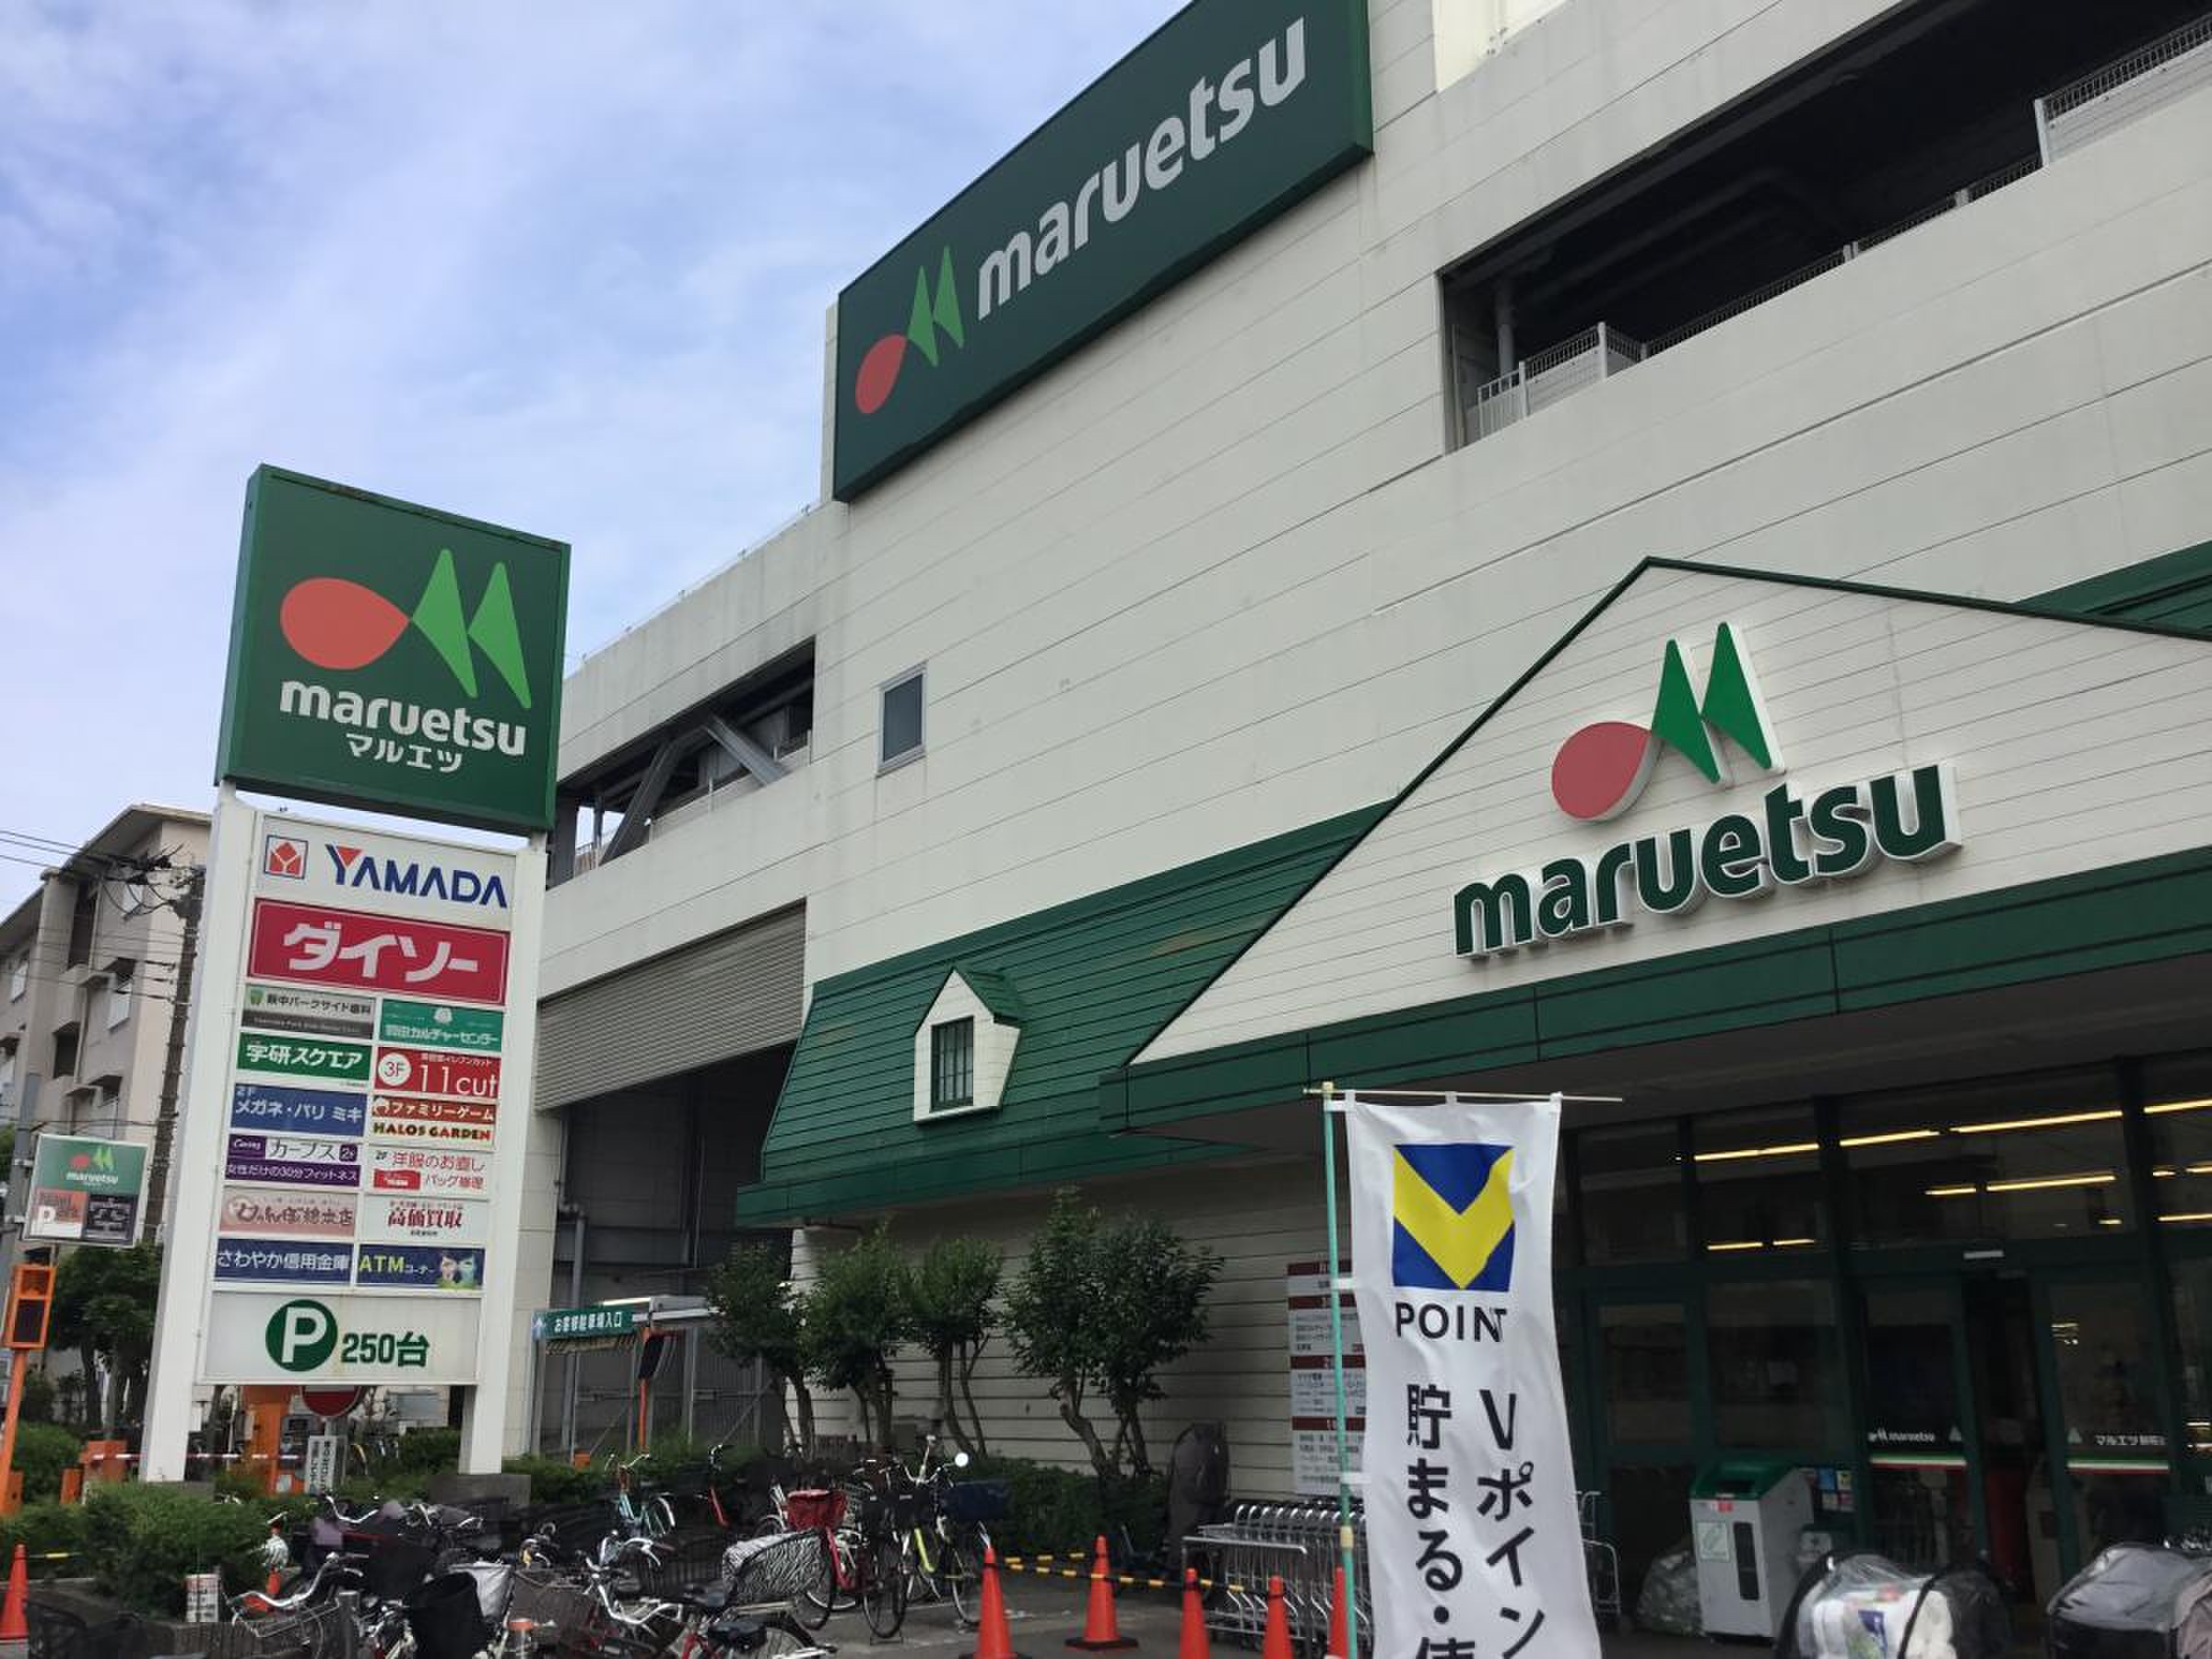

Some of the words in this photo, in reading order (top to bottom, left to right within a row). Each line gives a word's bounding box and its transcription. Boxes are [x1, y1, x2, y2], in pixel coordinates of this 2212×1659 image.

[978, 17, 1306, 322] maruetsu
[280, 679, 527, 757] maruetsu
[346, 733, 463, 773] マルエツ
[324, 843, 507, 908] YAMADA
[1454, 763, 1950, 957] maruetsu
[283, 921, 478, 982] ダイソー
[246, 1041, 363, 1069] 学研スクエア
[384, 1061, 405, 1077] 3F
[419, 1065, 498, 1097] 11cut
[373, 1123, 426, 1136] HALOS
[429, 1126, 490, 1140] GARDEN
[392, 1102, 494, 1121] ファミリーゲーム
[280, 1306, 328, 1364] P
[340, 1331, 430, 1368] 250台
